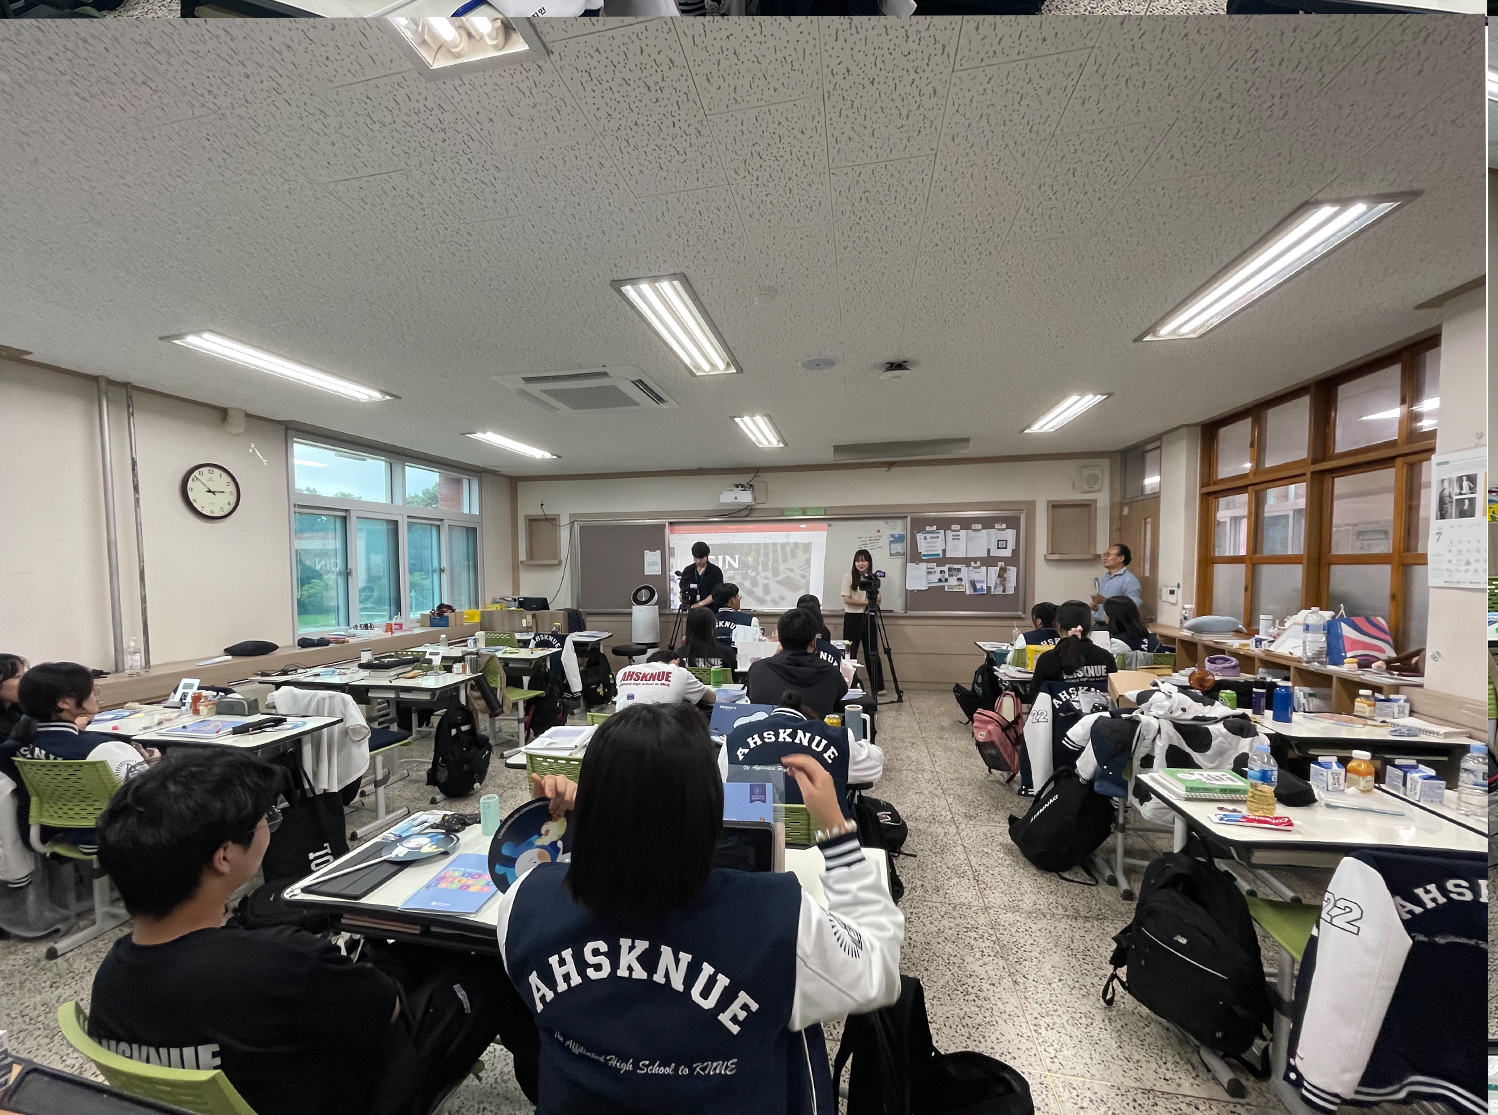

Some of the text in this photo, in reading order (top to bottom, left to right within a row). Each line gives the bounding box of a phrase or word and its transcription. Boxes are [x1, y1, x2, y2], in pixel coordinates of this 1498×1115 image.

[621, 671, 672, 683] AHSKNUE
[736, 728, 838, 764] AHSKNUE
[528, 938, 760, 1035] AHSKNUE
[606, 1054, 634, 1073] High
[637, 1059, 675, 1075] School
[678, 1062, 689, 1076] to
[693, 1059, 738, 1076] KNUE
